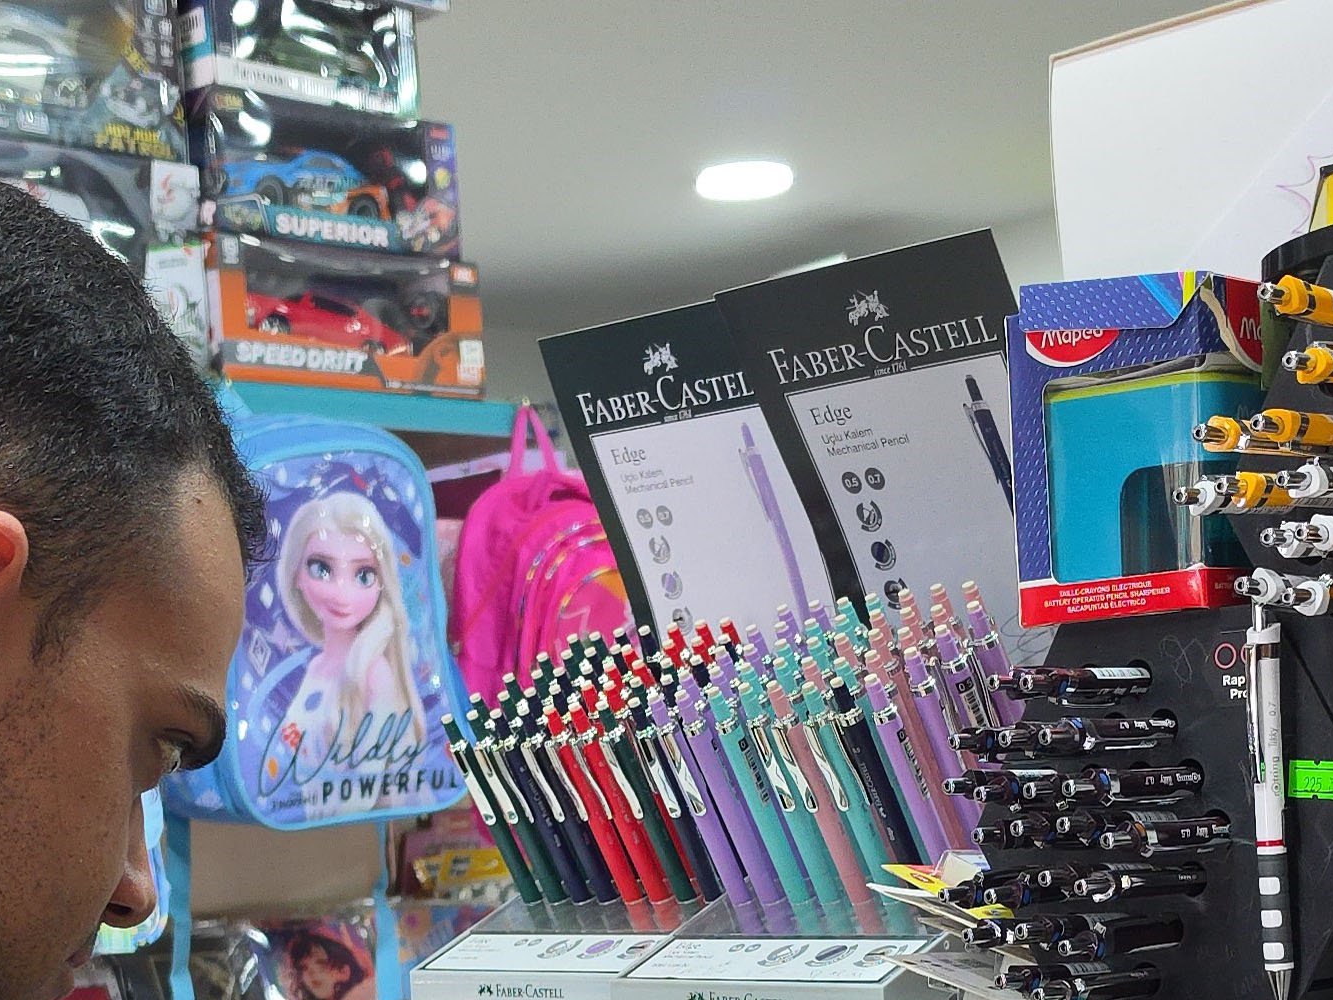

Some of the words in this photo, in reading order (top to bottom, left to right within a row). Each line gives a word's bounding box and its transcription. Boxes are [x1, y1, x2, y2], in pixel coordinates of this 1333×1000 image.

[275, 212, 389, 249] SUPERIOR
[767, 315, 998, 384] FABER-CASTELL
[874, 365, 891, 377] since
[892, 362, 907, 374] 1761
[810, 405, 852, 425] Edge
[844, 427, 874, 440] Kalem
[827, 441, 879, 457] Mechanical
[882, 434, 909, 448] Pencil
[611, 447, 646, 466] Edge
[845, 478, 858, 487] 0.5
[868, 475, 881, 483] 0.7
[1222, 675, 1245, 687] Rap
[258, 708, 431, 797] Wildly
[323, 770, 458, 804] POWERFUL
[495, 984, 564, 998] FABER-CASTELL
